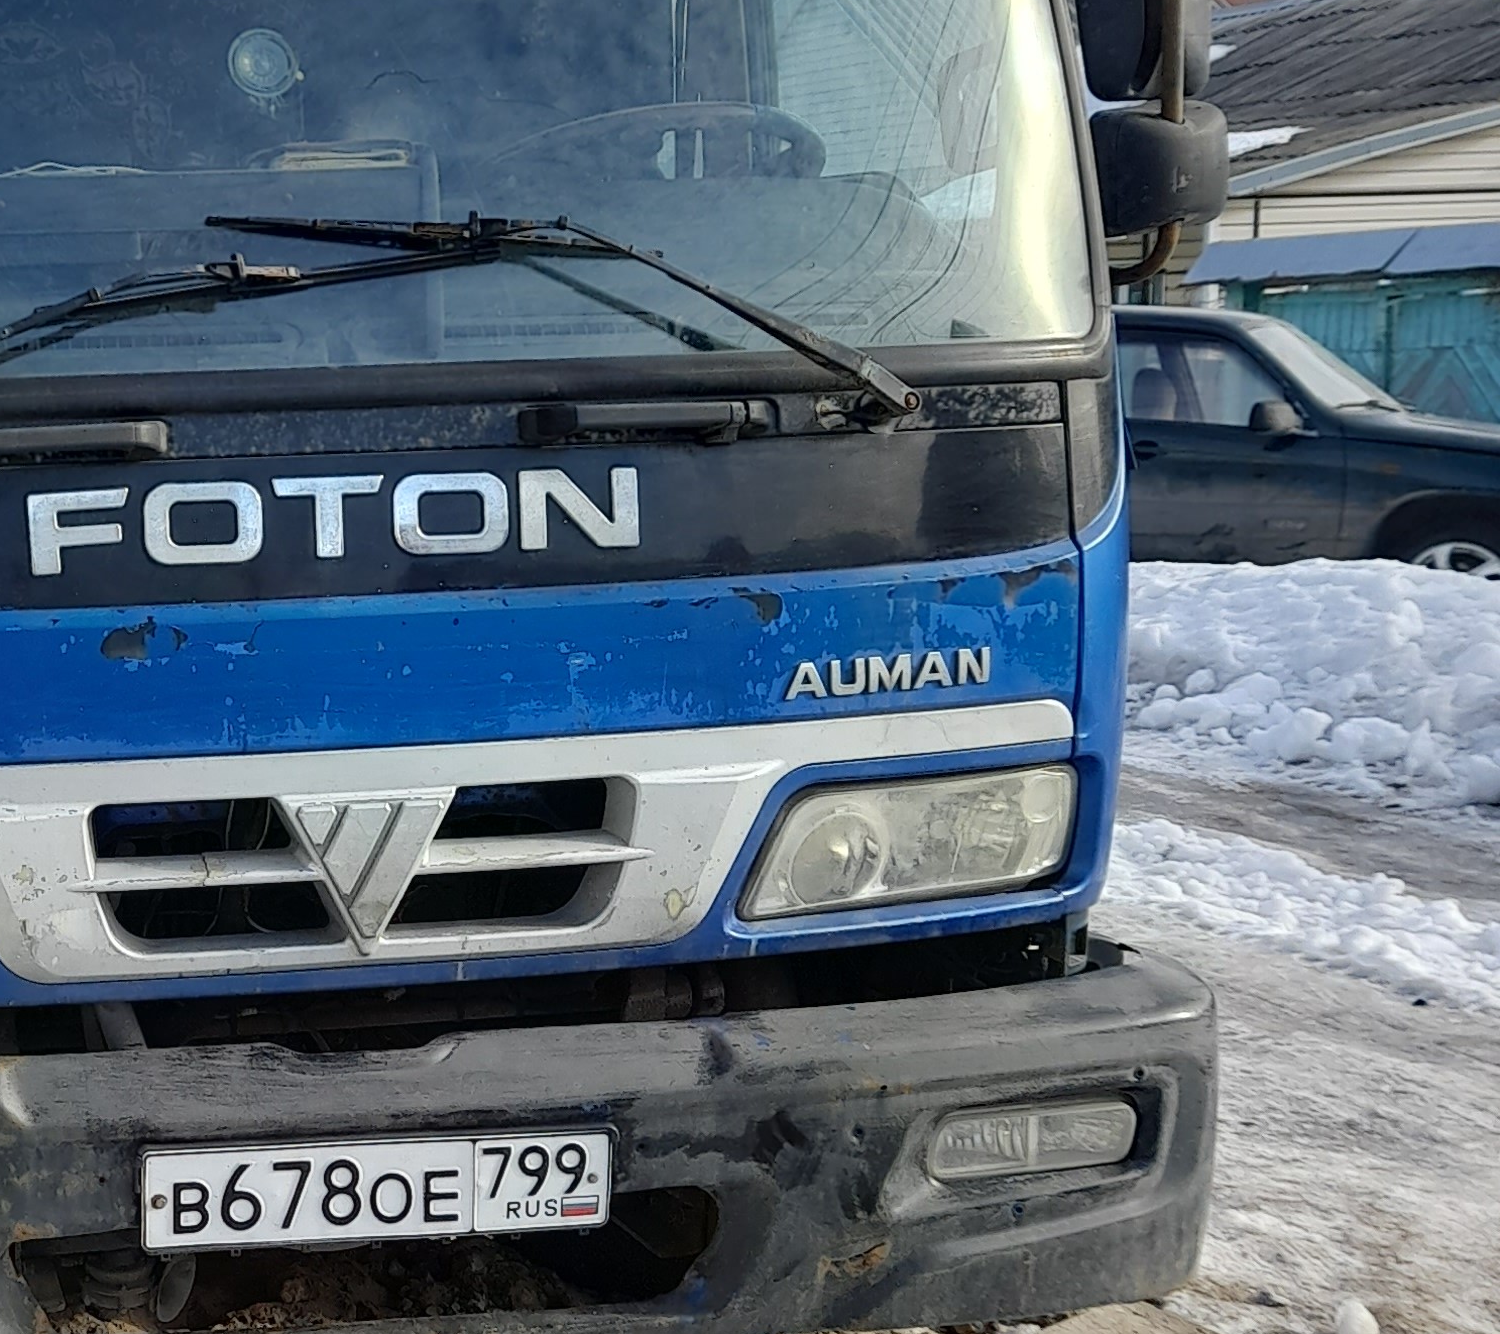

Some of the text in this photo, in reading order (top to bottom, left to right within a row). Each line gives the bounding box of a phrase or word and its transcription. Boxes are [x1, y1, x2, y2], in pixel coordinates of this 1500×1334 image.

[27, 465, 642, 577] FOTON
[784, 645, 993, 701] AUMAN
[171, 1143, 587, 1235] В678ОЕ 799
[506, 1197, 558, 1219] RUS
